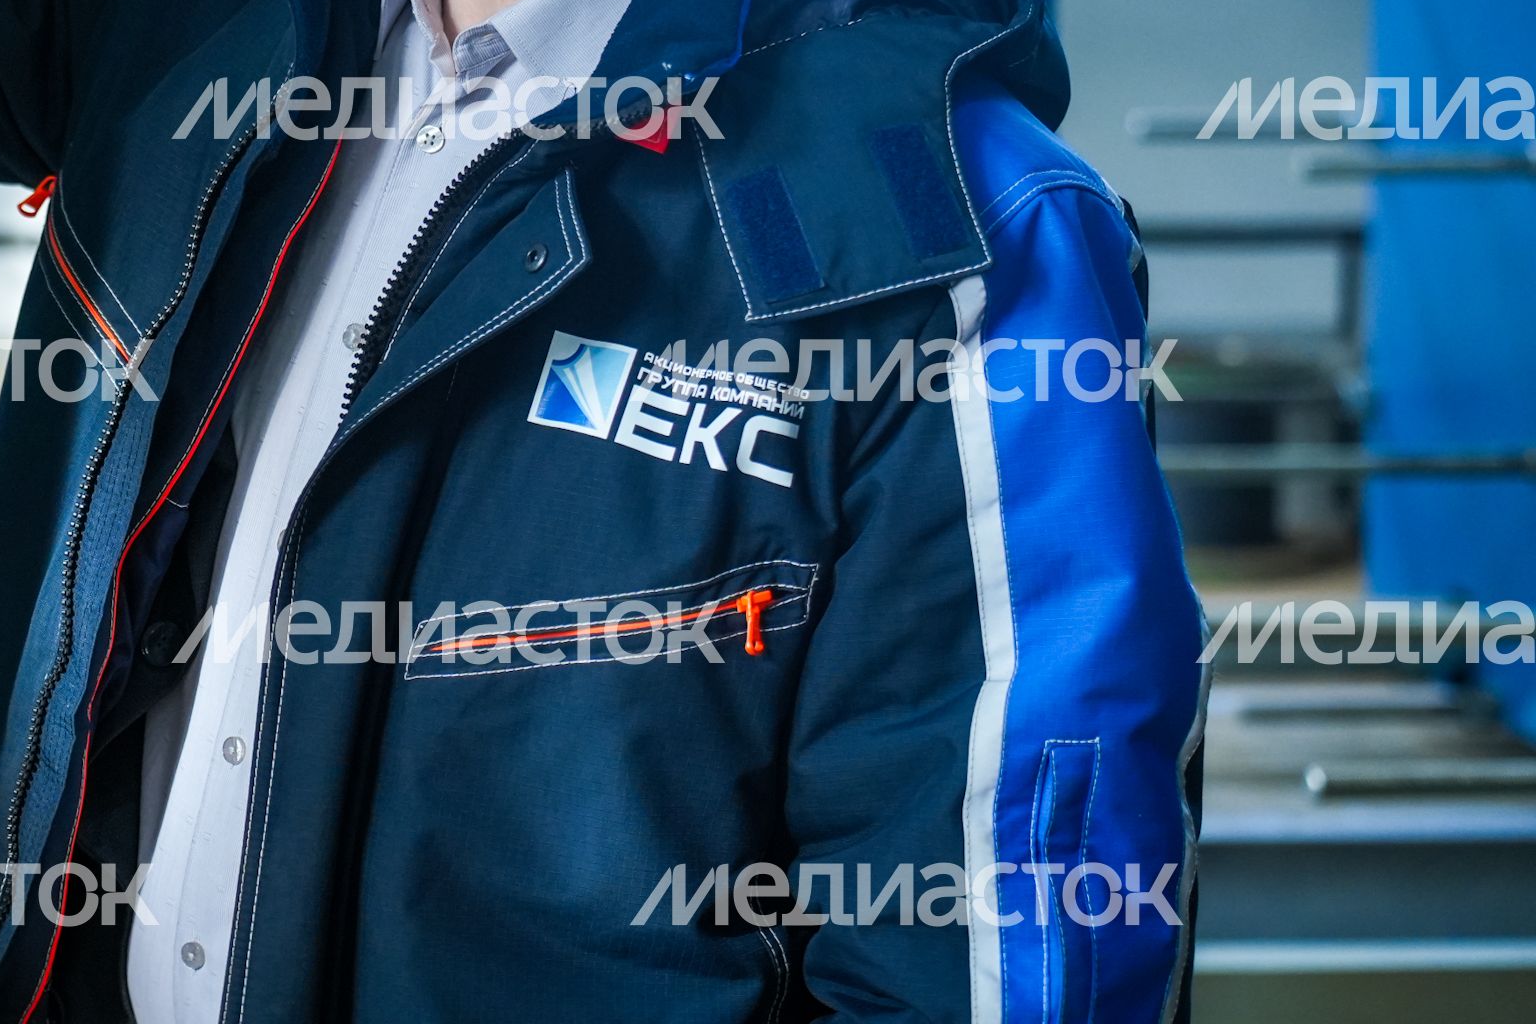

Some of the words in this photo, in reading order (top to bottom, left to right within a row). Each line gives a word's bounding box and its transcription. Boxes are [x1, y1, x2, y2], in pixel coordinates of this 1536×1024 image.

[636, 366, 707, 399] ГРУППА
[710, 386, 805, 420] КОМПАНИЙ
[643, 351, 734, 382] АКЦИОНЕРНОЕ
[736, 372, 810, 400] ОБЩЕСТВО
[613, 384, 800, 488] ЕКС
